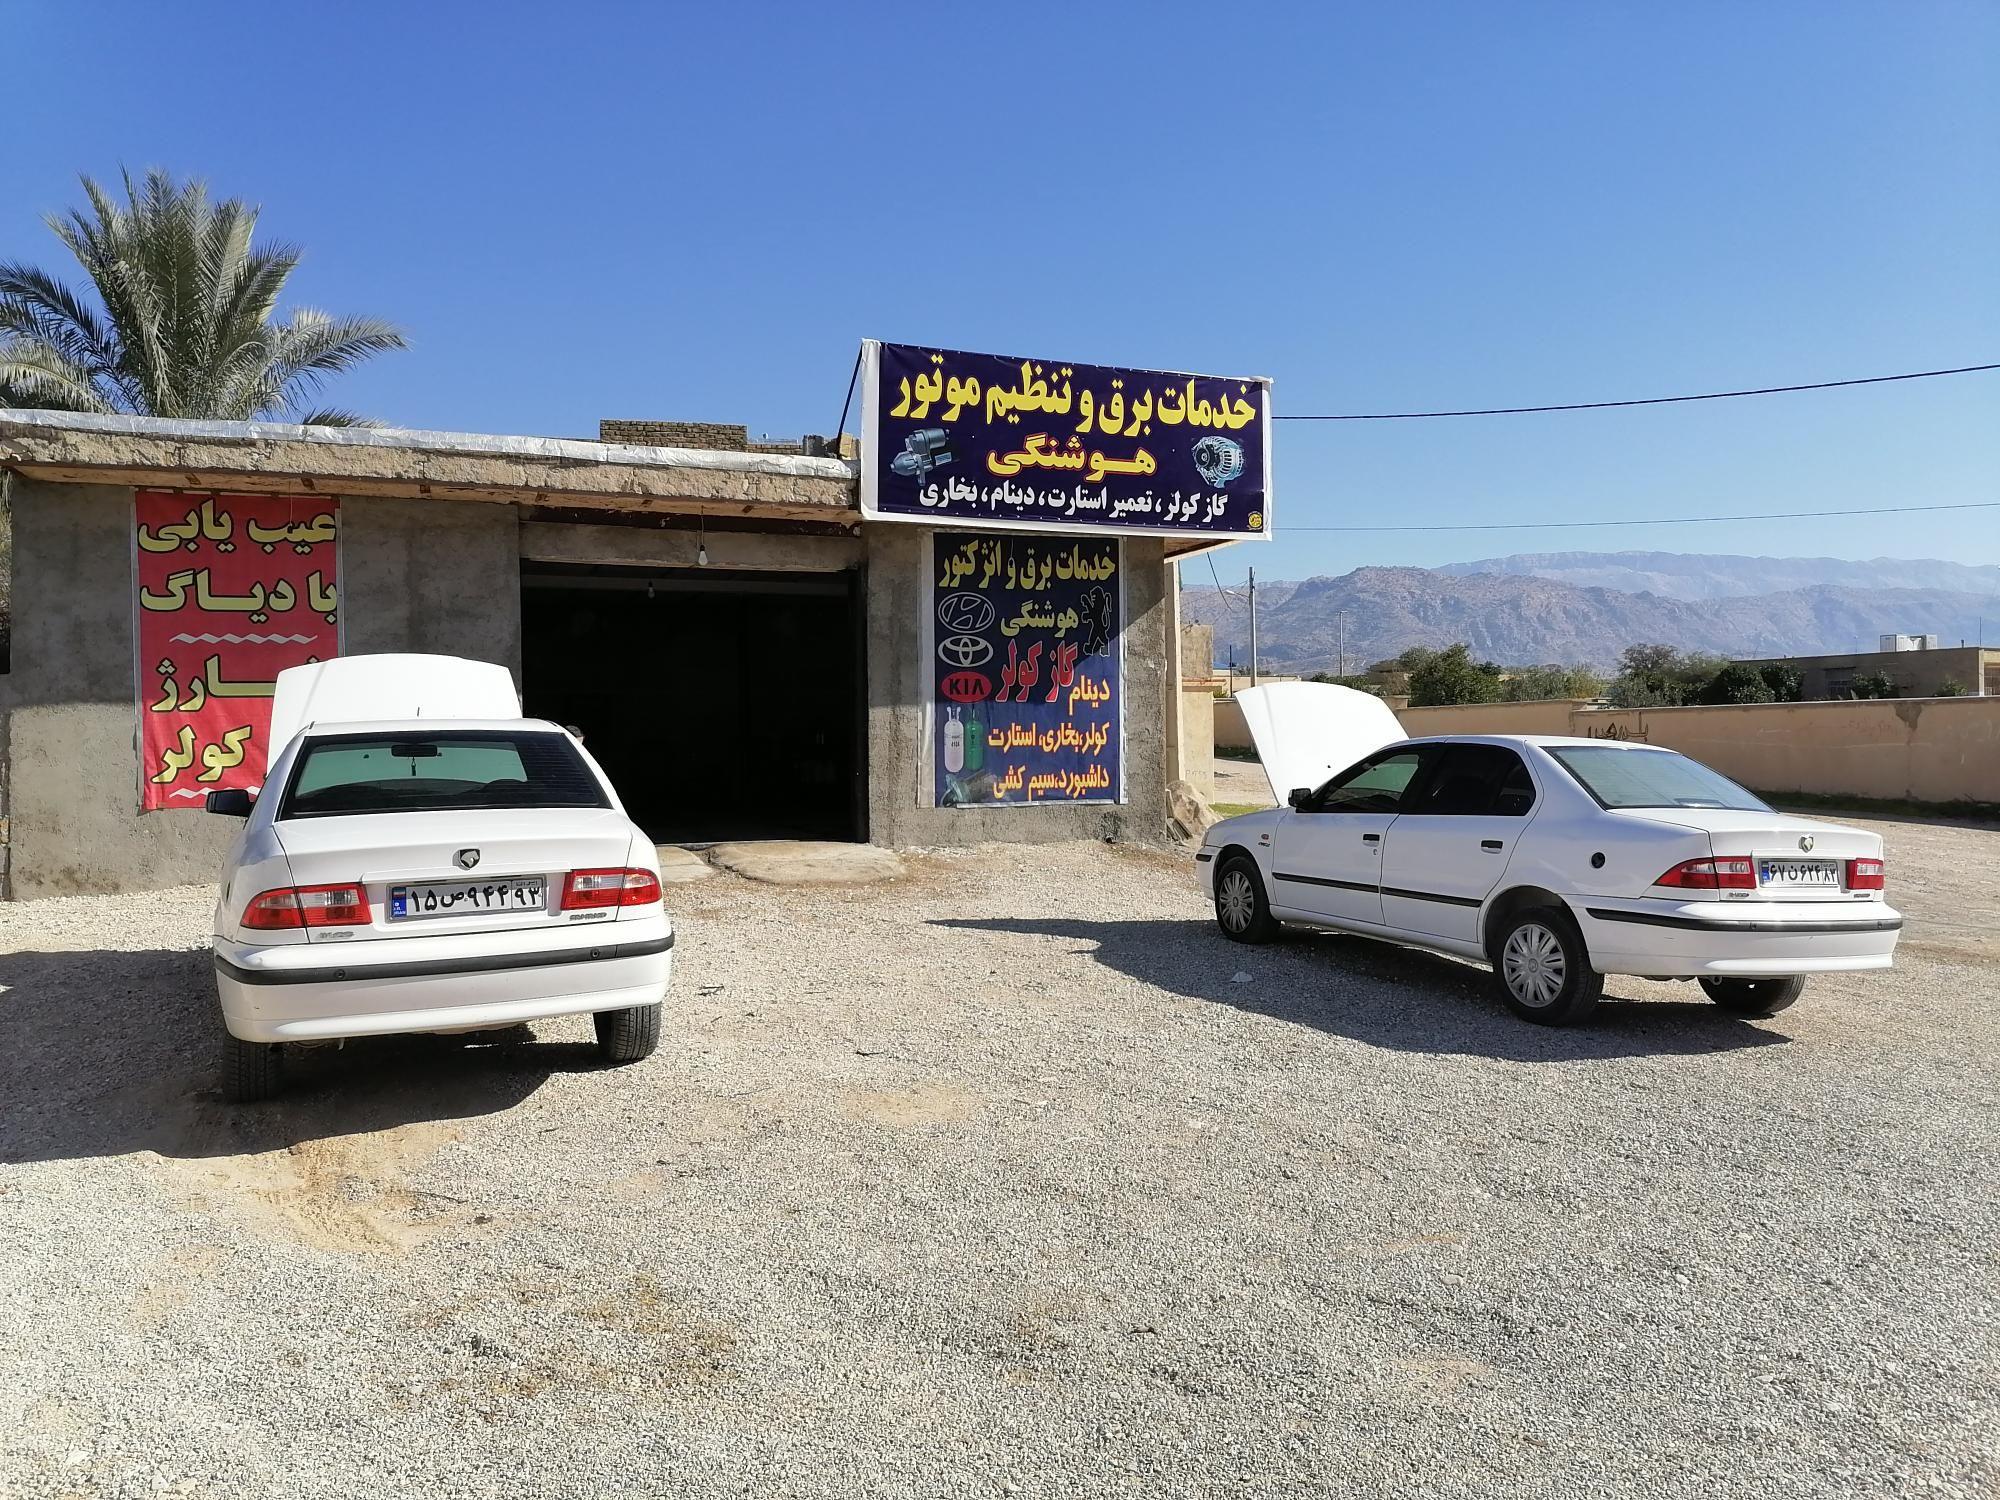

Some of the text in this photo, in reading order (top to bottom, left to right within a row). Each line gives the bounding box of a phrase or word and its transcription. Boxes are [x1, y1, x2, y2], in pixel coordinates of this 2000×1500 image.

[890, 354, 1256, 437] خدمات برق و تنظیم موتور
[986, 432, 1158, 482] هوشنگی
[919, 476, 978, 508] بخاری
[1109, 489, 1152, 518] تعمیر
[1201, 494, 1228, 523] گاز
[137, 499, 337, 555] عیب یابی
[1005, 557, 1015, 589] و
[1019, 548, 1052, 590] برق
[1055, 543, 1116, 581] خدمات
[140, 567, 338, 625] با دیاگ
[1000, 600, 1079, 638] هوشنگی
[150, 653, 278, 712] ارژ
[948, 677, 986, 697] KIA
[995, 638, 1079, 702] گاز کولر
[1068, 674, 1110, 715] دینام
[150, 724, 253, 785] کولر
[987, 722, 1036, 754] استارت
[993, 765, 1026, 799] کشی
